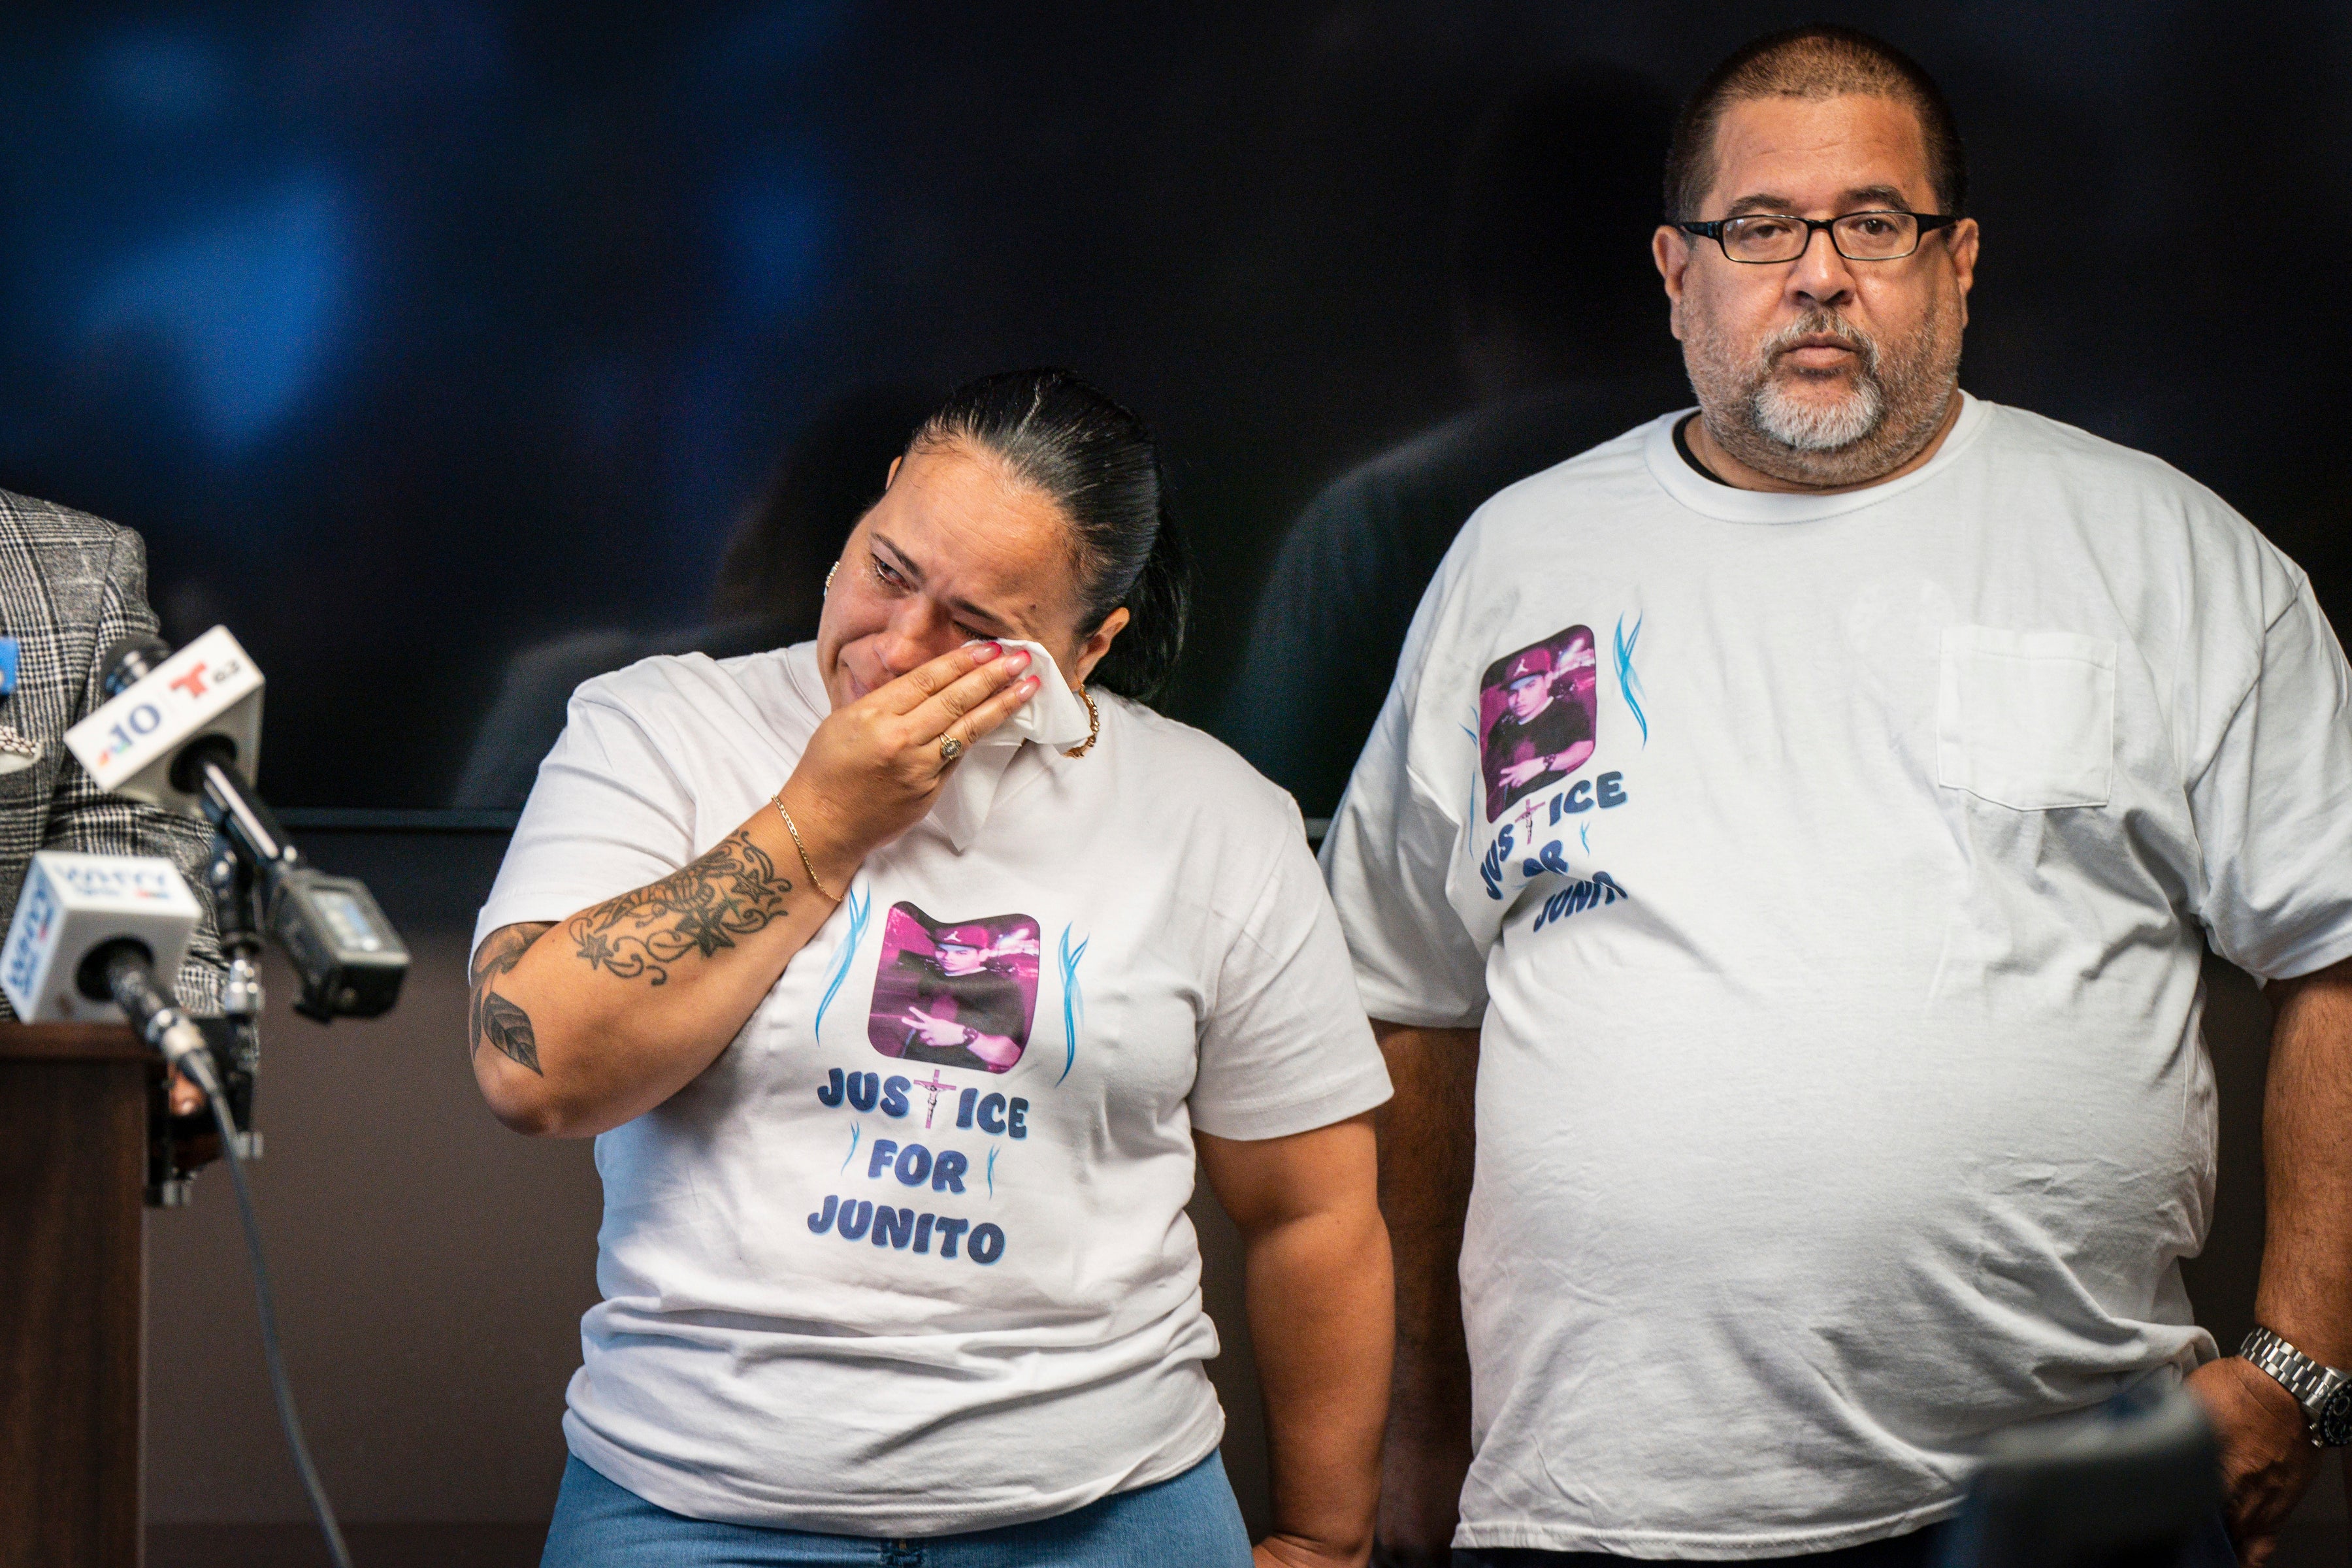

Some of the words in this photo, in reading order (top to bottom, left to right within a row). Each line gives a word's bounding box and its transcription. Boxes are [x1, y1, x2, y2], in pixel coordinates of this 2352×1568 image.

[109, 701, 161, 747] 10
[817, 1067, 1030, 1141] JUSTICE
[867, 1139, 970, 1194] FOR
[807, 1194, 1007, 1266] JUNITO
